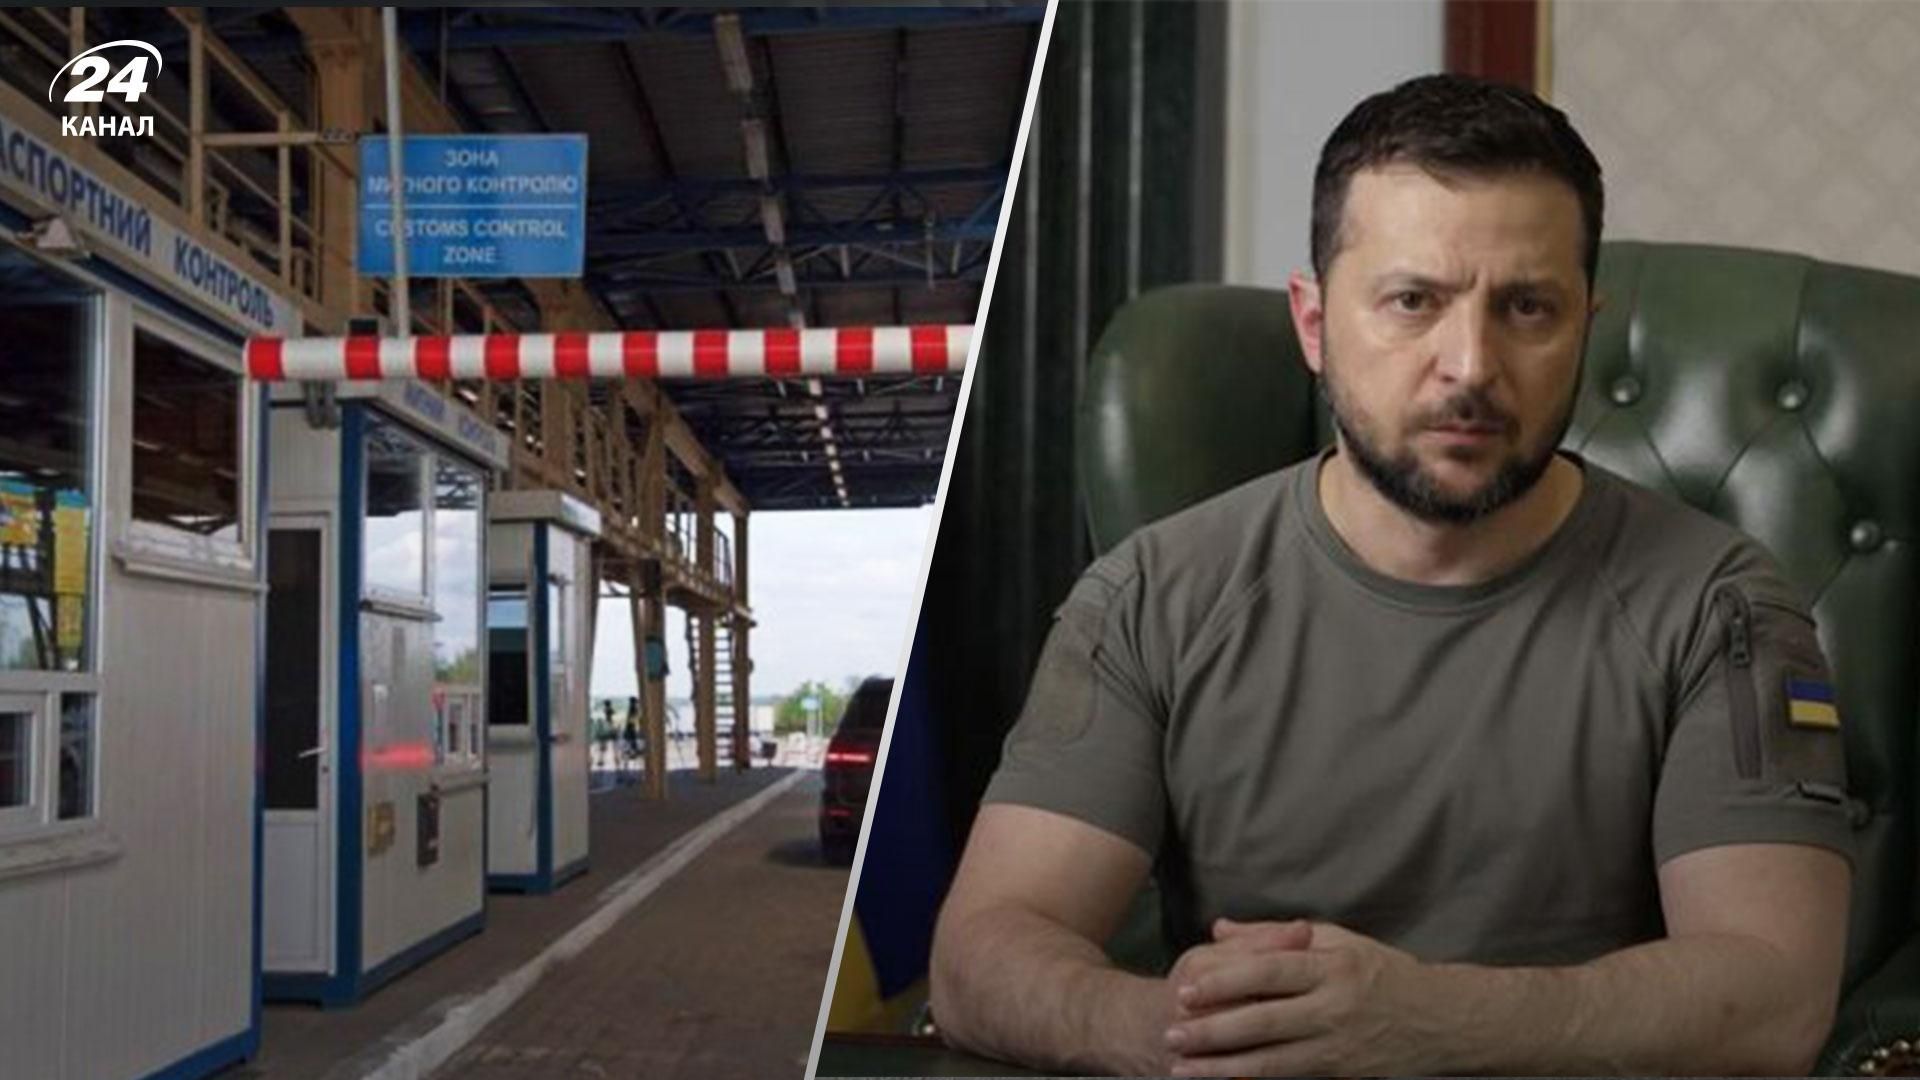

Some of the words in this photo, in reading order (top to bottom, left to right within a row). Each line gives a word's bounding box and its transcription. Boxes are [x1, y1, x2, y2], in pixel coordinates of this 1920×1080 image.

[445, 150, 499, 167] ЗОНА
[466, 175, 578, 194] КОНТРОЛЮ
[473, 219, 567, 237] CONTROL
[443, 247, 497, 264] ZONE
[174, 235, 274, 328] КОНТРОЛЬ
